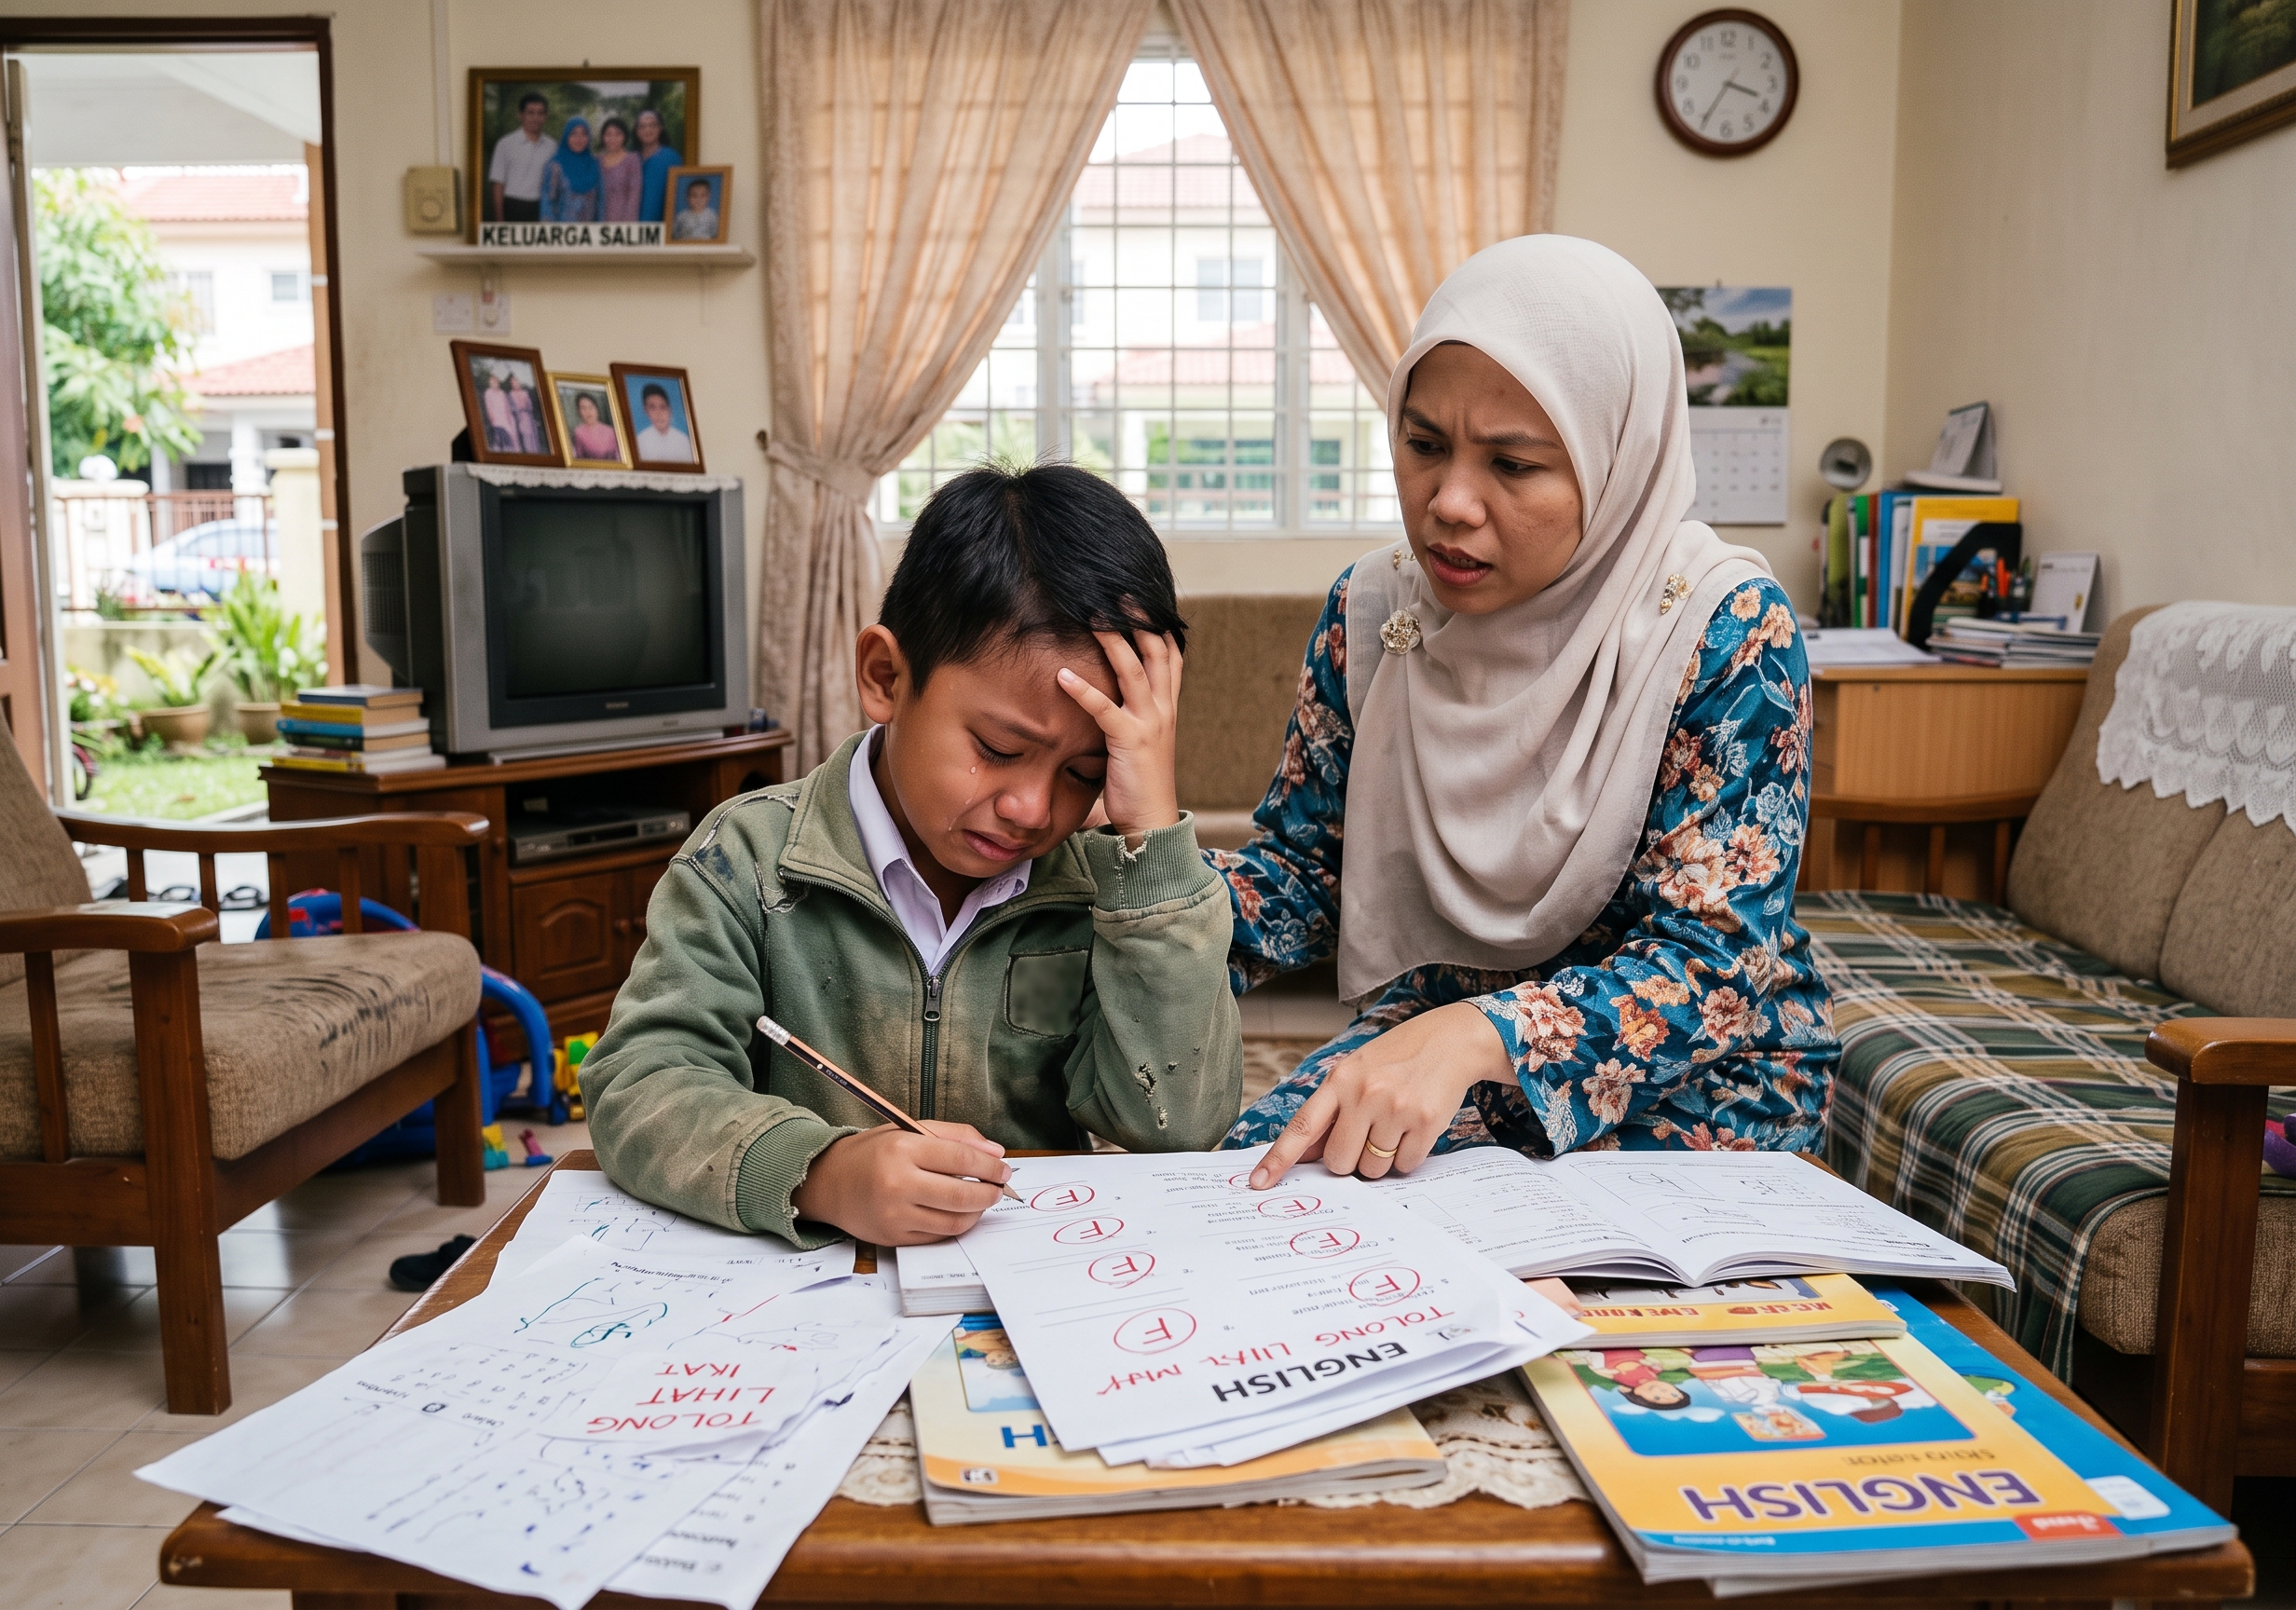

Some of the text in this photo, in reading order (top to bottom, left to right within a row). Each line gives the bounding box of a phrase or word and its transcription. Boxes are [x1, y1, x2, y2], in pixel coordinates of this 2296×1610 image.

[1759, 51, 1772, 71] 2
[483, 225, 661, 247] KELUARGA SALIM
[1056, 1189, 1080, 1205] F
[1281, 1198, 1308, 1212] F
[1080, 1221, 1104, 1239] F
[1318, 1232, 1343, 1248] F
[1112, 1256, 1140, 1276] F
[1374, 1274, 1402, 1295] F
[1142, 1317, 1173, 1344] F
[1314, 1305, 1456, 1346] TOLONG
[655, 1362, 742, 1379] IKAT
[1212, 1342, 1408, 1402] ENGLISH
[636, 1387, 776, 1405] LIHAT
[586, 1411, 761, 1434] TOLONG
[1684, 1471, 2040, 1520] ENGLISH
